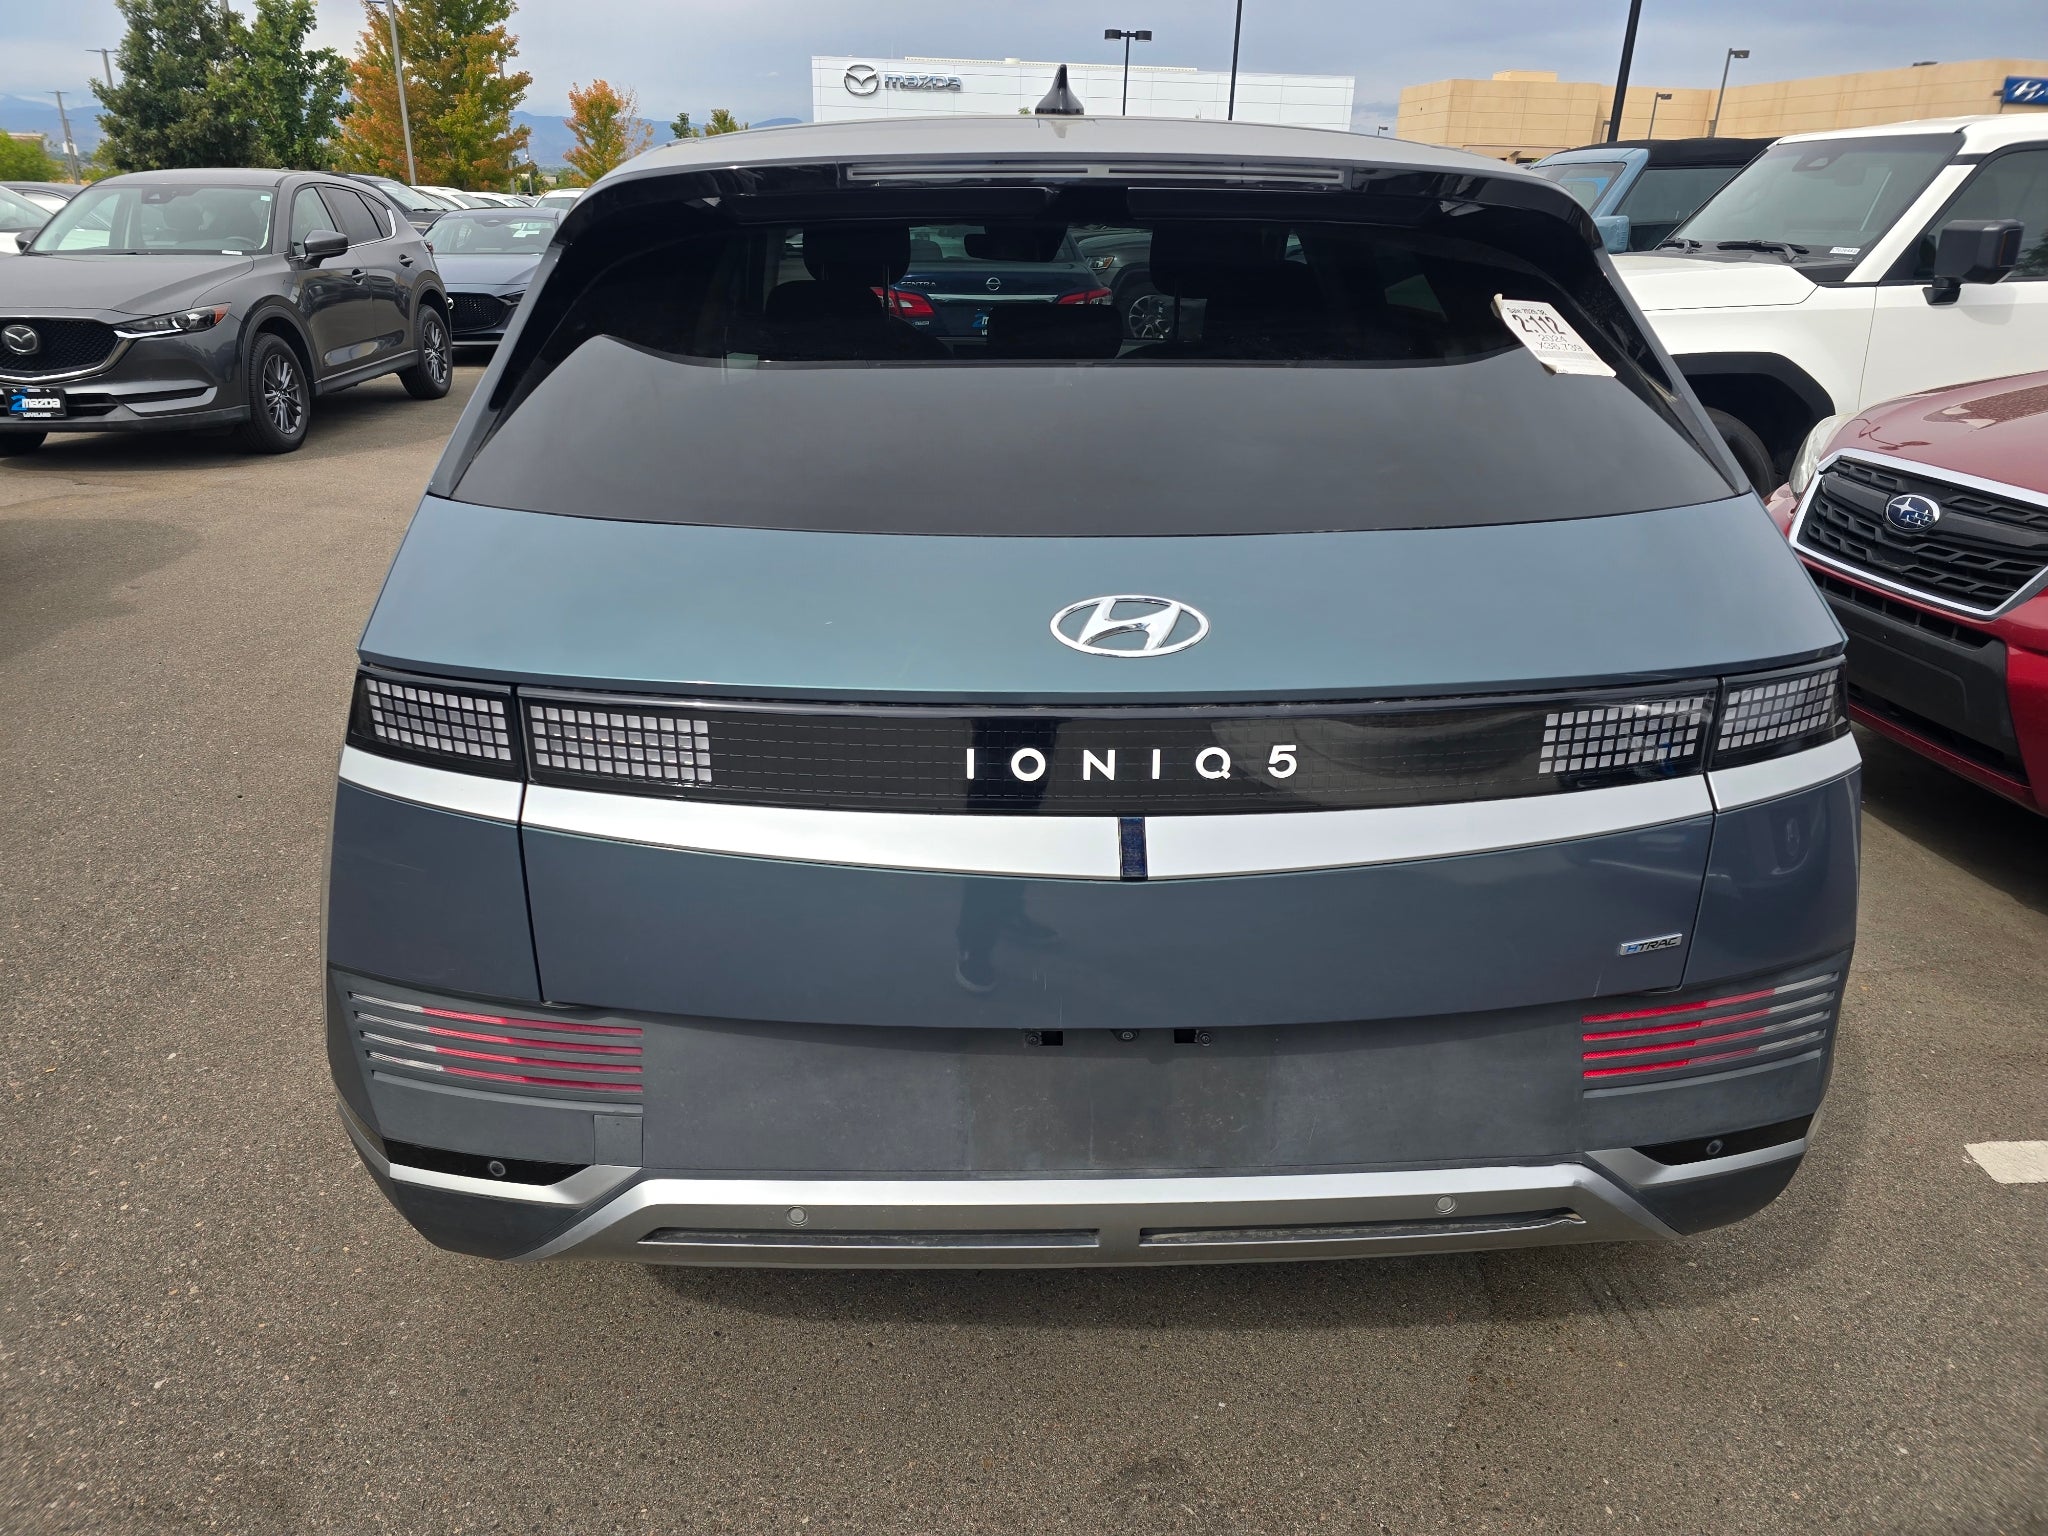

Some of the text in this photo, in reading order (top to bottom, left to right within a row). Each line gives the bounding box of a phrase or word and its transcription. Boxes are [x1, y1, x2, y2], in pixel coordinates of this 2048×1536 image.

[884, 73, 961, 91] mazda
[965, 744, 1298, 782] IONIQ 5
[1626, 937, 1678, 953] HTRAC
